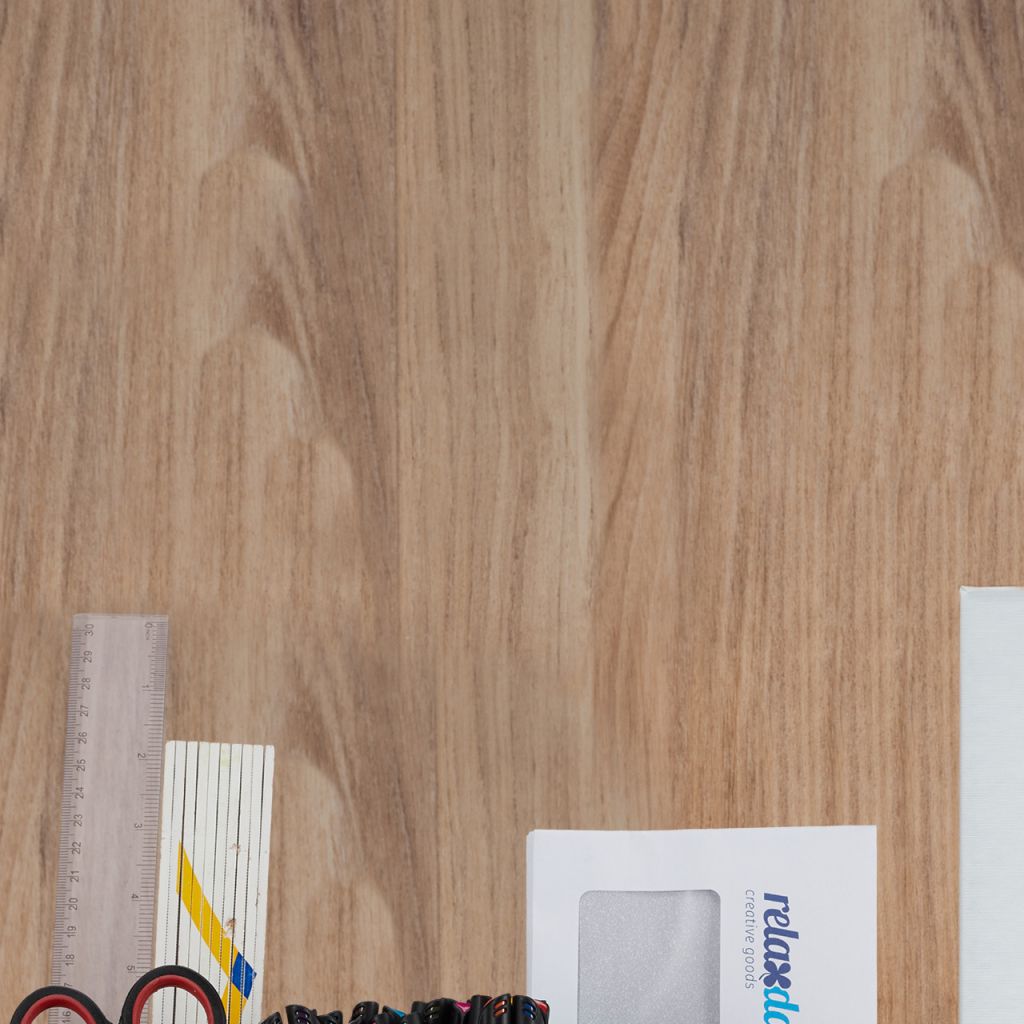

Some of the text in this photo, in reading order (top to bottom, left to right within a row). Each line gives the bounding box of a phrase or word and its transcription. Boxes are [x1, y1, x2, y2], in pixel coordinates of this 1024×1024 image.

[84, 623, 94, 637] 30
[82, 650, 93, 663] 29
[81, 677, 91, 690] 28
[80, 704, 89, 717] 27
[77, 731, 88, 745] 26
[76, 758, 86, 772] 25
[74, 786, 84, 799] 24
[72, 814, 83, 827] 23
[71, 841, 81, 855] 22
[69, 870, 80, 882] 21
[68, 897, 79, 911] 20
[66, 925, 77, 938] 19
[742, 889, 757, 989] creative goods
[64, 953, 75, 967] 18
[61, 1010, 72, 1024] 16
